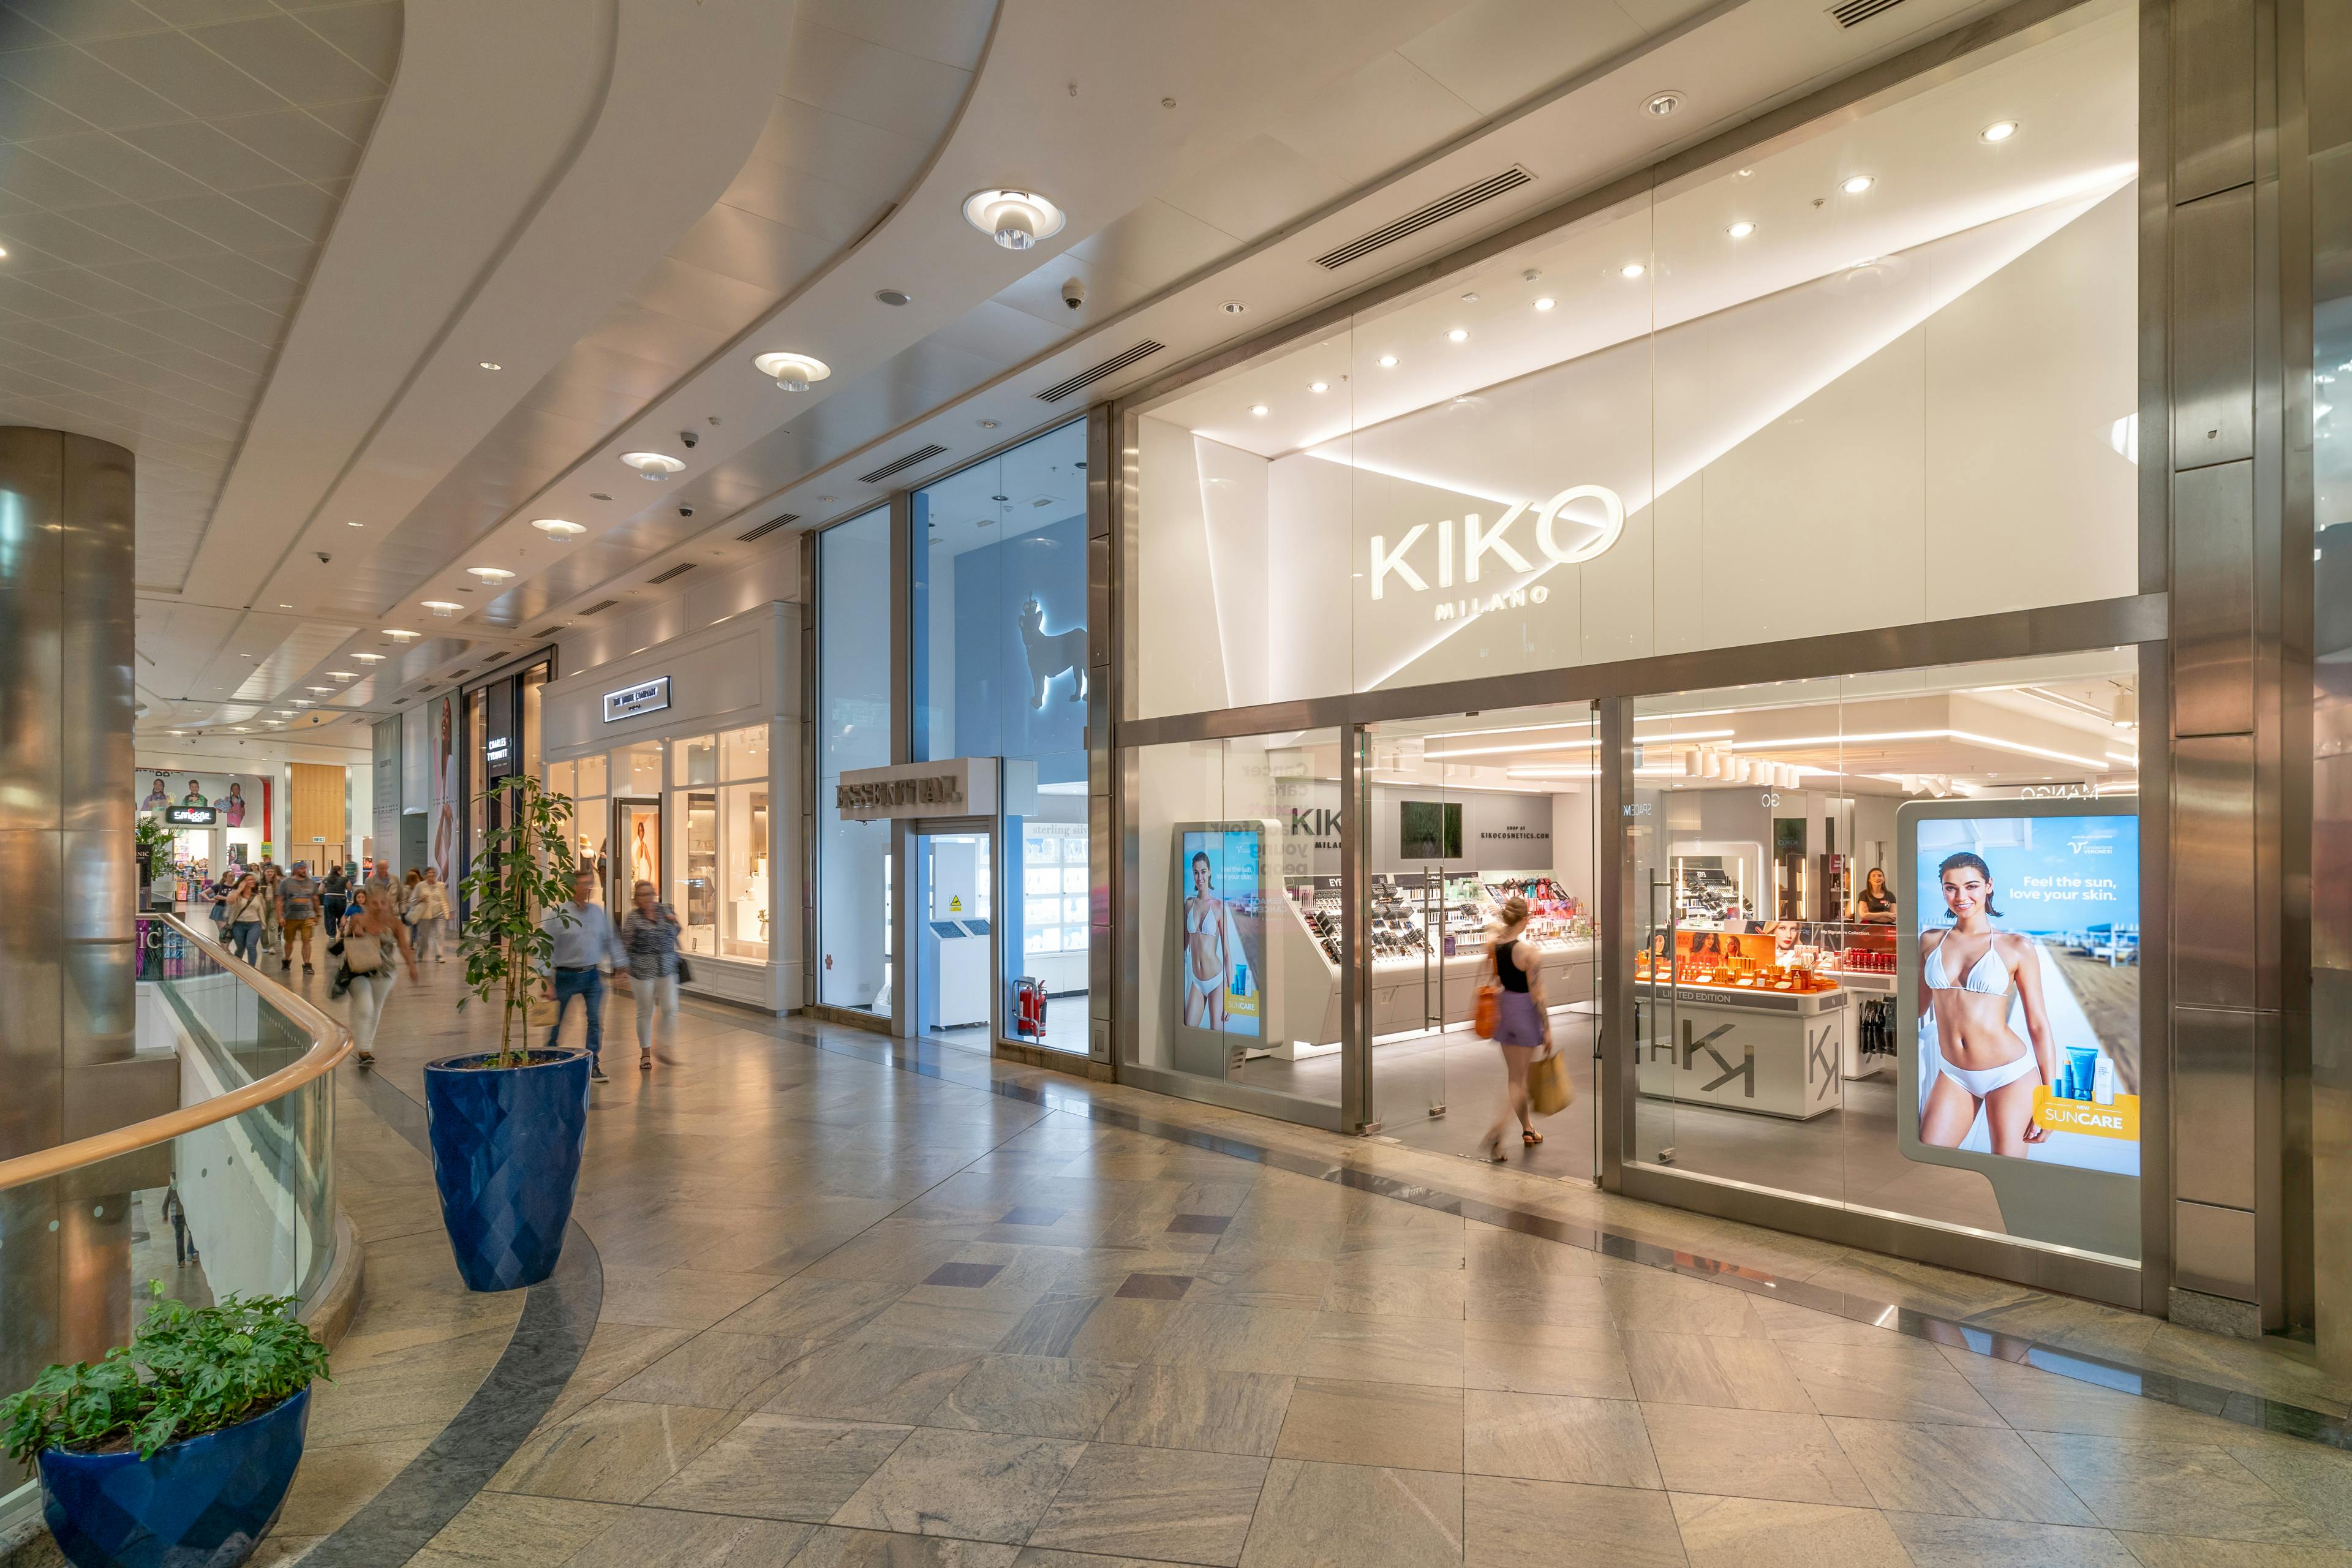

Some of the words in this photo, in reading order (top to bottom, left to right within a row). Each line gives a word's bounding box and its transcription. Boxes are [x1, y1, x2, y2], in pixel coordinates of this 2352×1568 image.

[1371, 484, 1626, 600] KIKO
[1434, 586, 1551, 621] MILANO
[1292, 808, 1341, 835] KIK
[1033, 824, 1069, 837] sterling
[1072, 825, 1088, 834] silv
[1329, 878, 1342, 887] EYE
[2024, 876, 2052, 887] Feel
[2056, 876, 2082, 888] the
[2084, 878, 2117, 889] sun,
[2010, 888, 2041, 900] love
[2043, 891, 2079, 902] your
[2082, 889, 2117, 901] skin.
[1662, 990, 1694, 1000] LITED
[1695, 993, 1731, 1003] EDITION
[2045, 1109, 2122, 1129] SUNCARE
